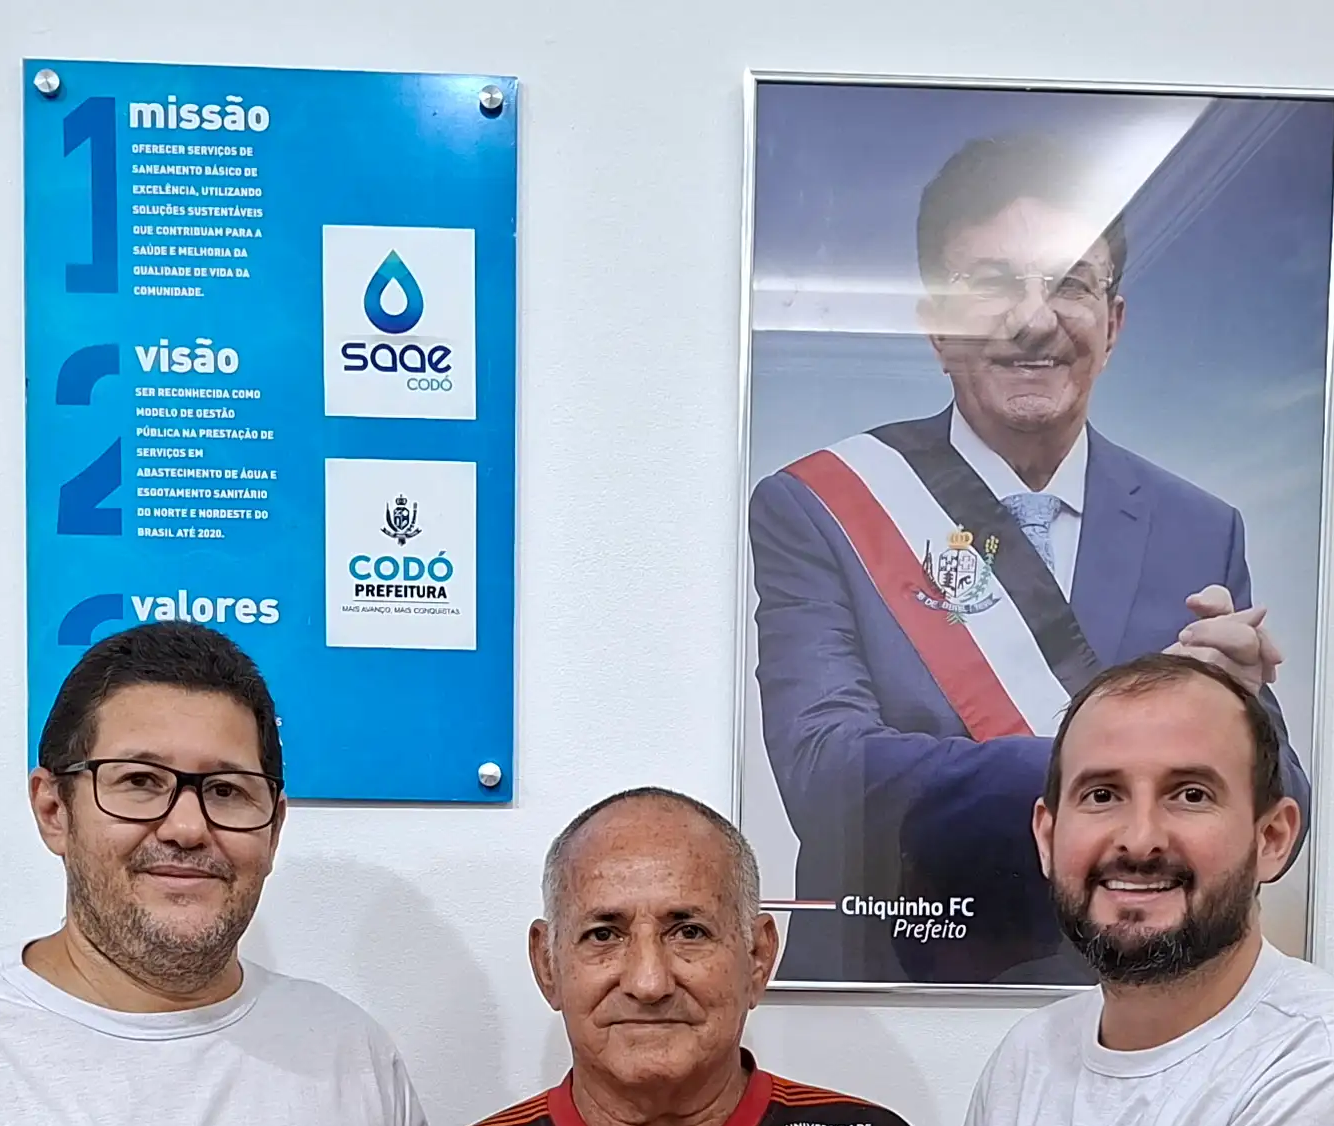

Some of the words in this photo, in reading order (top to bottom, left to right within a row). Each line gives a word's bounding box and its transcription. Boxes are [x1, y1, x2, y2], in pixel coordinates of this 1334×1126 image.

[129, 95, 270, 132] missão
[131, 143, 185, 154] OFERECER
[187, 145, 237, 157] SERVIÇOS
[239, 146, 253, 157] DE
[131, 164, 203, 175] SANEAMENTO
[204, 164, 242, 177] BÁSICO
[244, 167, 258, 177] DE
[132, 182, 199, 196] EXCELÊNCIA,
[201, 186, 262, 197] UTILIZANDO
[132, 203, 185, 217] SOLUÇÕES
[187, 204, 264, 218] SUSTENTÁVEIS
[133, 225, 154, 235] QUE
[156, 226, 223, 237] CONTRIBUAM
[225, 227, 253, 238] PARA
[254, 228, 263, 238] A
[133, 242, 168, 256] SAÚDE
[169, 246, 177, 256] E
[178, 246, 232, 257] MELHORIA
[233, 248, 248, 258] DA
[133, 265, 192, 277] QUALIDADE
[194, 267, 208, 277] DE
[209, 267, 234, 278] VIDA
[235, 268, 250, 278] DA
[133, 285, 205, 297] COMUNIDADE.
[135, 338, 240, 374] visão
[407, 375, 453, 392] CODÓ
[135, 387, 156, 397] SER
[157, 388, 230, 399] RECONHECIDA
[231, 389, 261, 399] COMO
[136, 407, 178, 418] MODELO
[180, 408, 194, 418] DE
[195, 407, 235, 419] GESTÃO
[136, 425, 181, 438] PÚBLICA
[182, 428, 197, 438] NA
[199, 427, 258, 441] PRESTAÇÃO
[260, 430, 274, 440] DE
[136, 447, 186, 459] SERVIÇOS
[188, 448, 204, 458] EM
[136, 467, 223, 479] ABASTECIMENTO
[224, 469, 238, 479] DE
[240, 467, 269, 480] ÁGUA
[270, 470, 277, 480] E
[137, 487, 212, 498] ESGOTAMENTO
[213, 488, 268, 499] SANITÁRIO
[137, 507, 151, 517] DO
[153, 507, 188, 518] NORTE
[189, 508, 197, 518] E
[198, 508, 252, 519] NORDESTE
[254, 509, 269, 519] DO
[137, 527, 175, 537] BRASIL
[175, 526, 196, 538] ATÉ
[197, 528, 225, 538] 2020.
[349, 550, 454, 582] CODÓ
[354, 583, 448, 599] PREFEITURA
[130, 589, 280, 625] valores
[342, 605, 360, 613] MAIS
[841, 895, 944, 920] Chiquinho
[949, 896, 975, 917] FC
[892, 918, 968, 943] Prefeito
